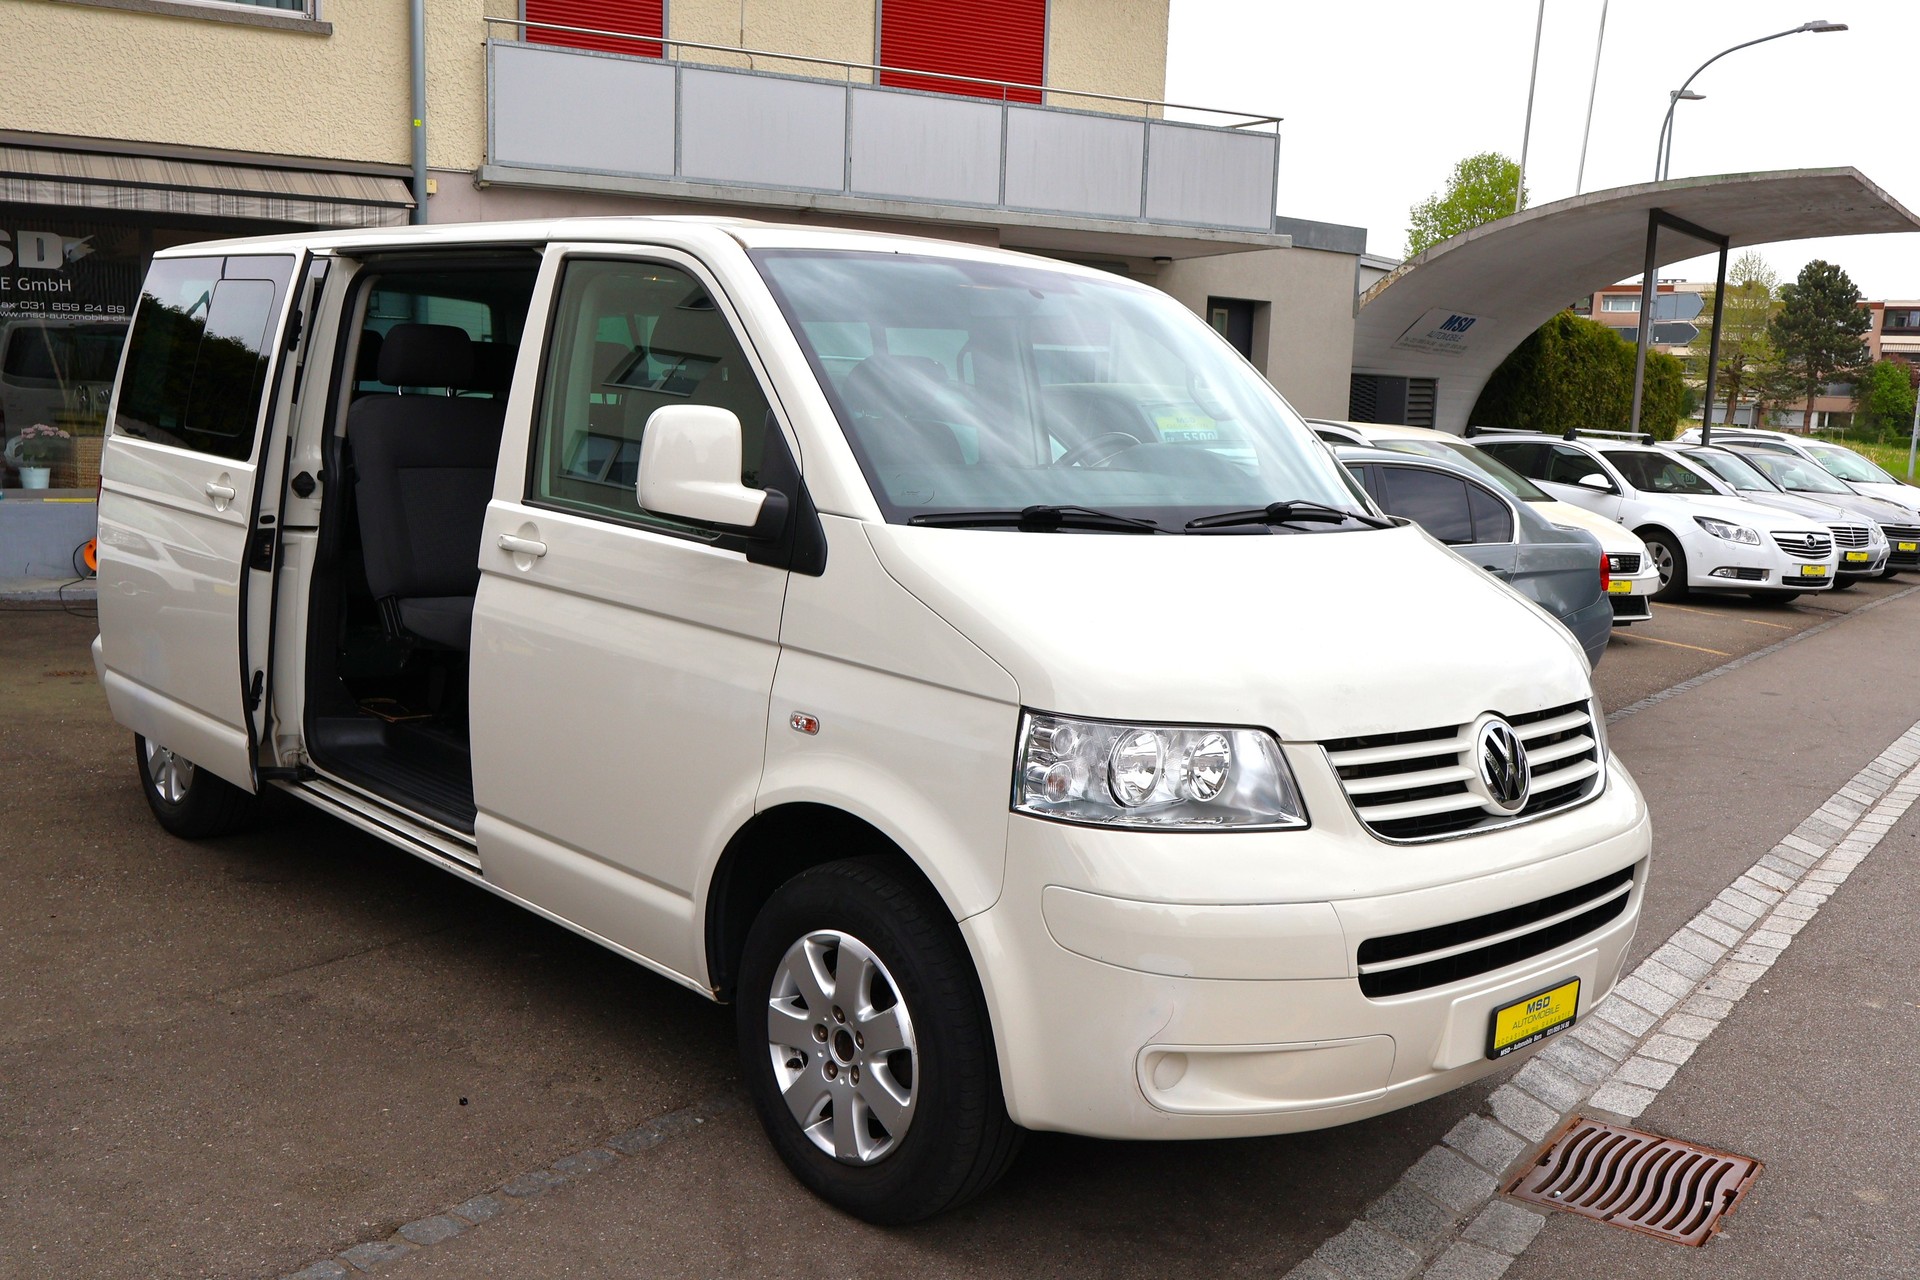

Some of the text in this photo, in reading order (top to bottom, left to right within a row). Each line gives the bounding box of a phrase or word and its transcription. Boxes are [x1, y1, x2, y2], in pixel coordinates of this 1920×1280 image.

[17, 277, 72, 292] GmbH
[20, 300, 45, 310] 031
[52, 302, 80, 312] 859
[84, 304, 102, 313] 24
[107, 305, 125, 314] 89
[1439, 314, 1476, 332] MSD
[1526, 996, 1551, 1015] MSD
[1511, 1003, 1561, 1030] AUTOMOBILE
